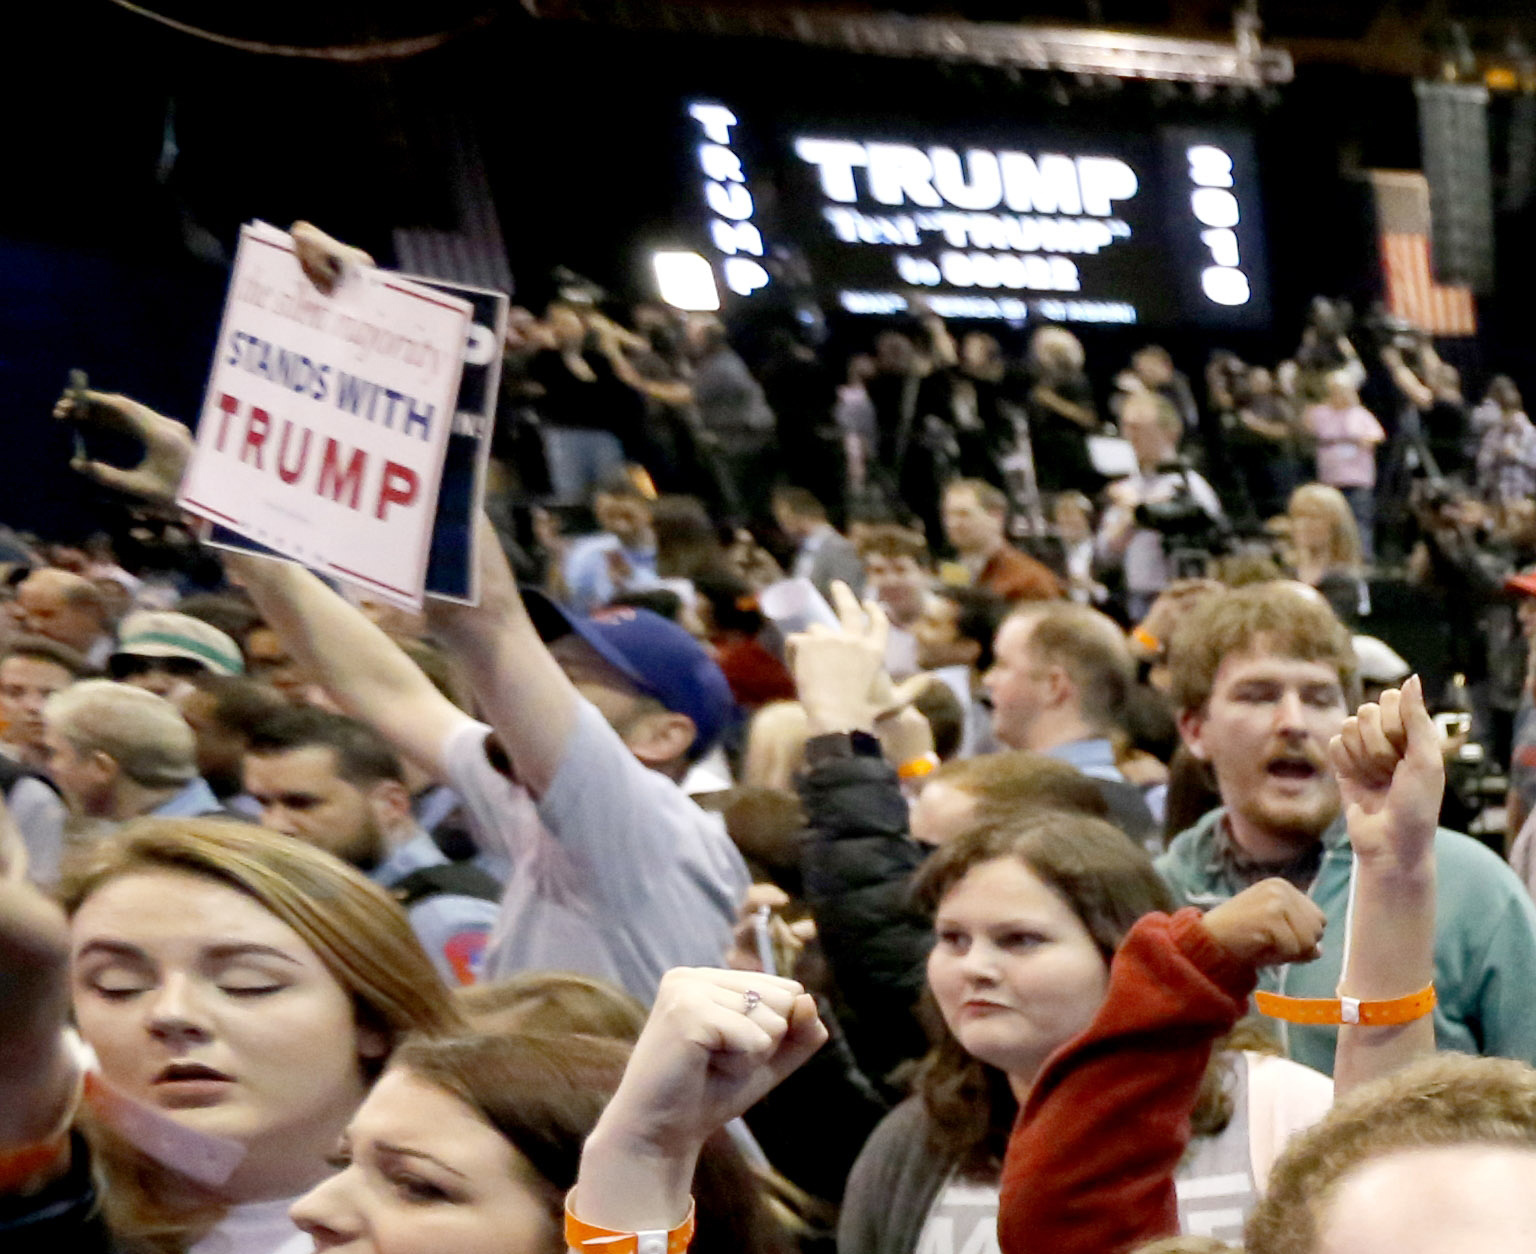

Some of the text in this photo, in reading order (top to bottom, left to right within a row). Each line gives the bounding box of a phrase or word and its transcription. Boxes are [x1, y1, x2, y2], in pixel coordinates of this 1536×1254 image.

[795, 138, 1138, 217] TRUMP
[226, 328, 436, 443] STANDS WITH
[216, 392, 422, 521] TRUMP
